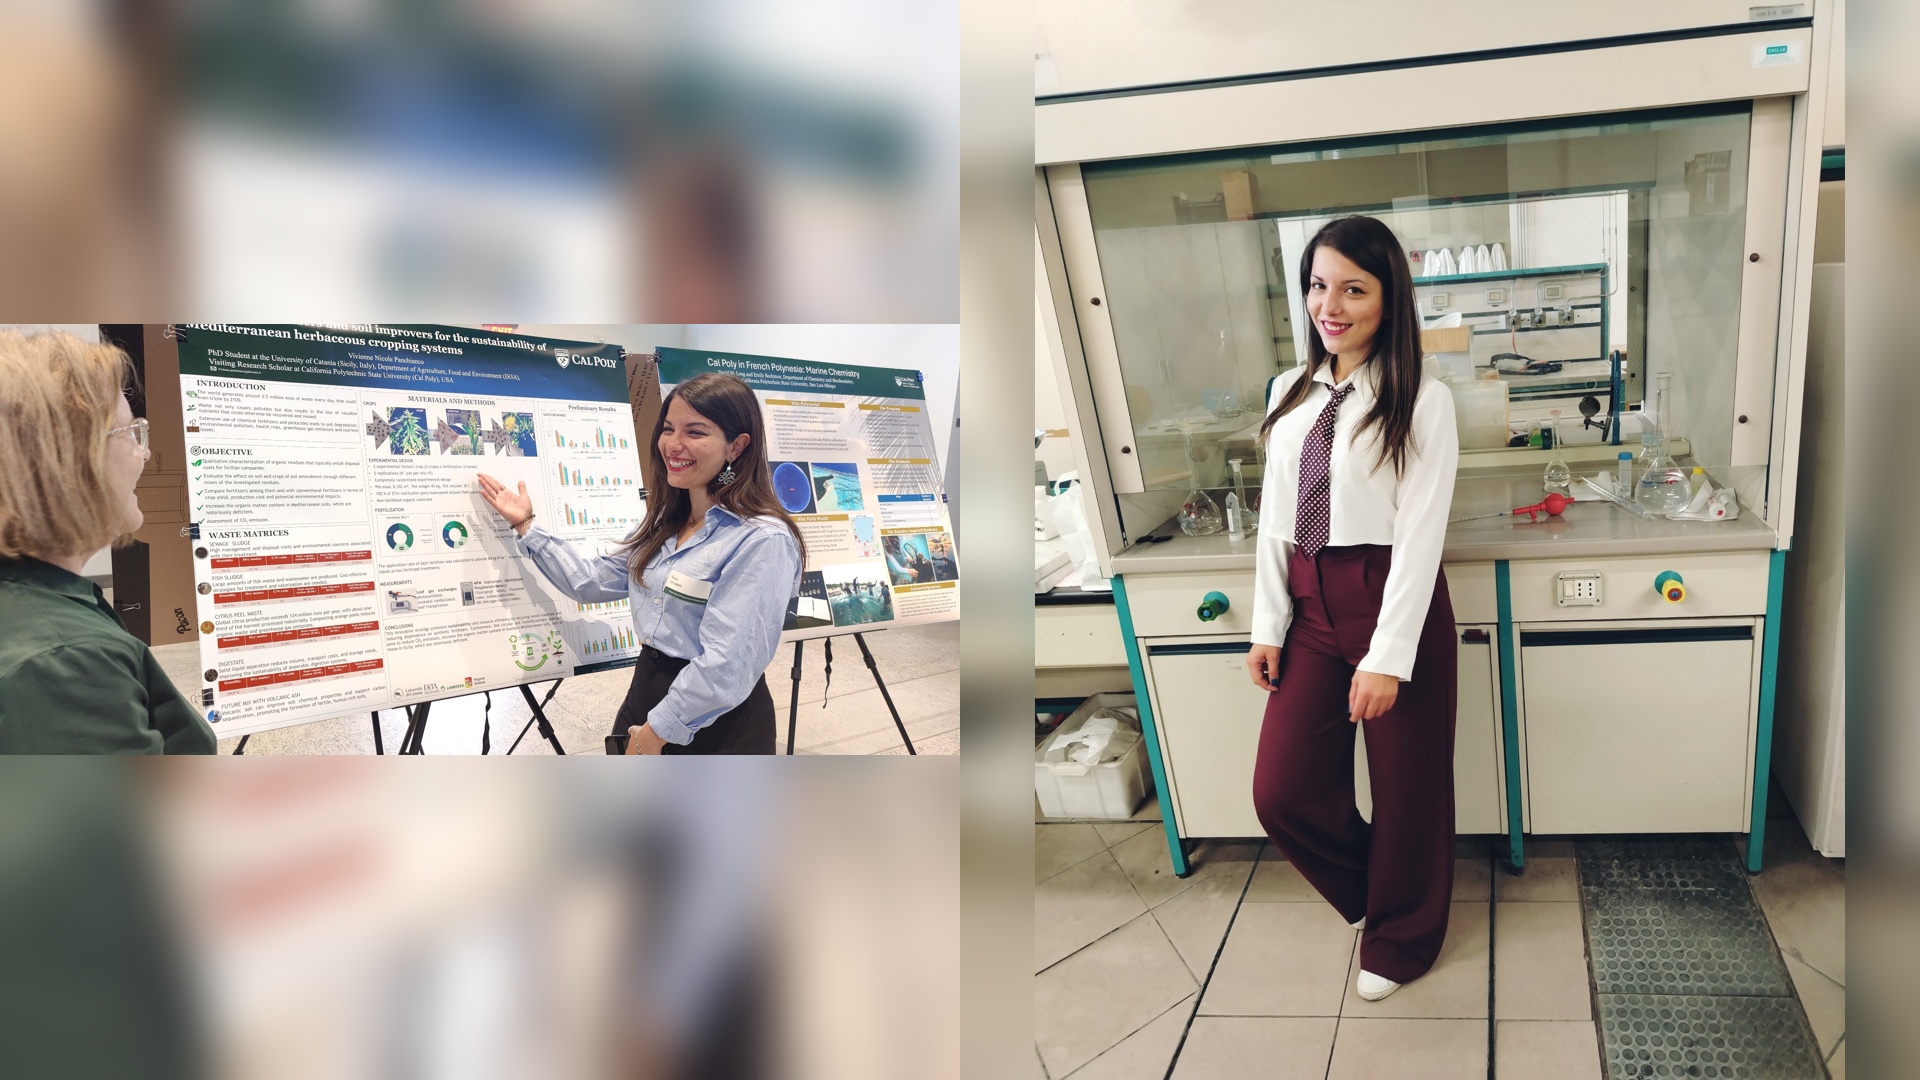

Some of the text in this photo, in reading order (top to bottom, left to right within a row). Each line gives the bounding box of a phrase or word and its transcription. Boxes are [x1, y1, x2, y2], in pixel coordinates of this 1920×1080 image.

[294, 328, 366, 346] herbaceous
[368, 339, 419, 353] cropping
[422, 344, 463, 355] systems
[352, 324, 372, 333] soil
[375, 325, 432, 339] improvers
[435, 330, 451, 341] for
[453, 332, 469, 343] the
[472, 335, 535, 351] sustainability
[537, 342, 547, 351] of
[208, 358, 235, 368] Visiting
[237, 361, 267, 369] Research
[301, 366, 331, 374] California
[333, 369, 366, 377] Polytechnic
[383, 373, 411, 381] University
[225, 351, 250, 359] Student
[271, 355, 304, 364] University
[338, 360, 358, 369] (Sicily,
[360, 362, 376, 370] Italy),
[378, 364, 409, 373] Department
[572, 354, 617, 368] CAL POLY
[708, 358, 720, 366] Cal
[722, 359, 736, 370] Poly
[746, 361, 770, 370] French
[771, 363, 804, 373] Polynesia:
[806, 366, 828, 375] Marine
[828, 368, 860, 379] Chemistry
[196, 380, 266, 391] INTRODUCTION
[408, 396, 448, 404] MATERIALS
[244, 530, 289, 538] MATRICES
[174, 608, 191, 634] Pacon
[222, 713, 255, 722] sequestration,
